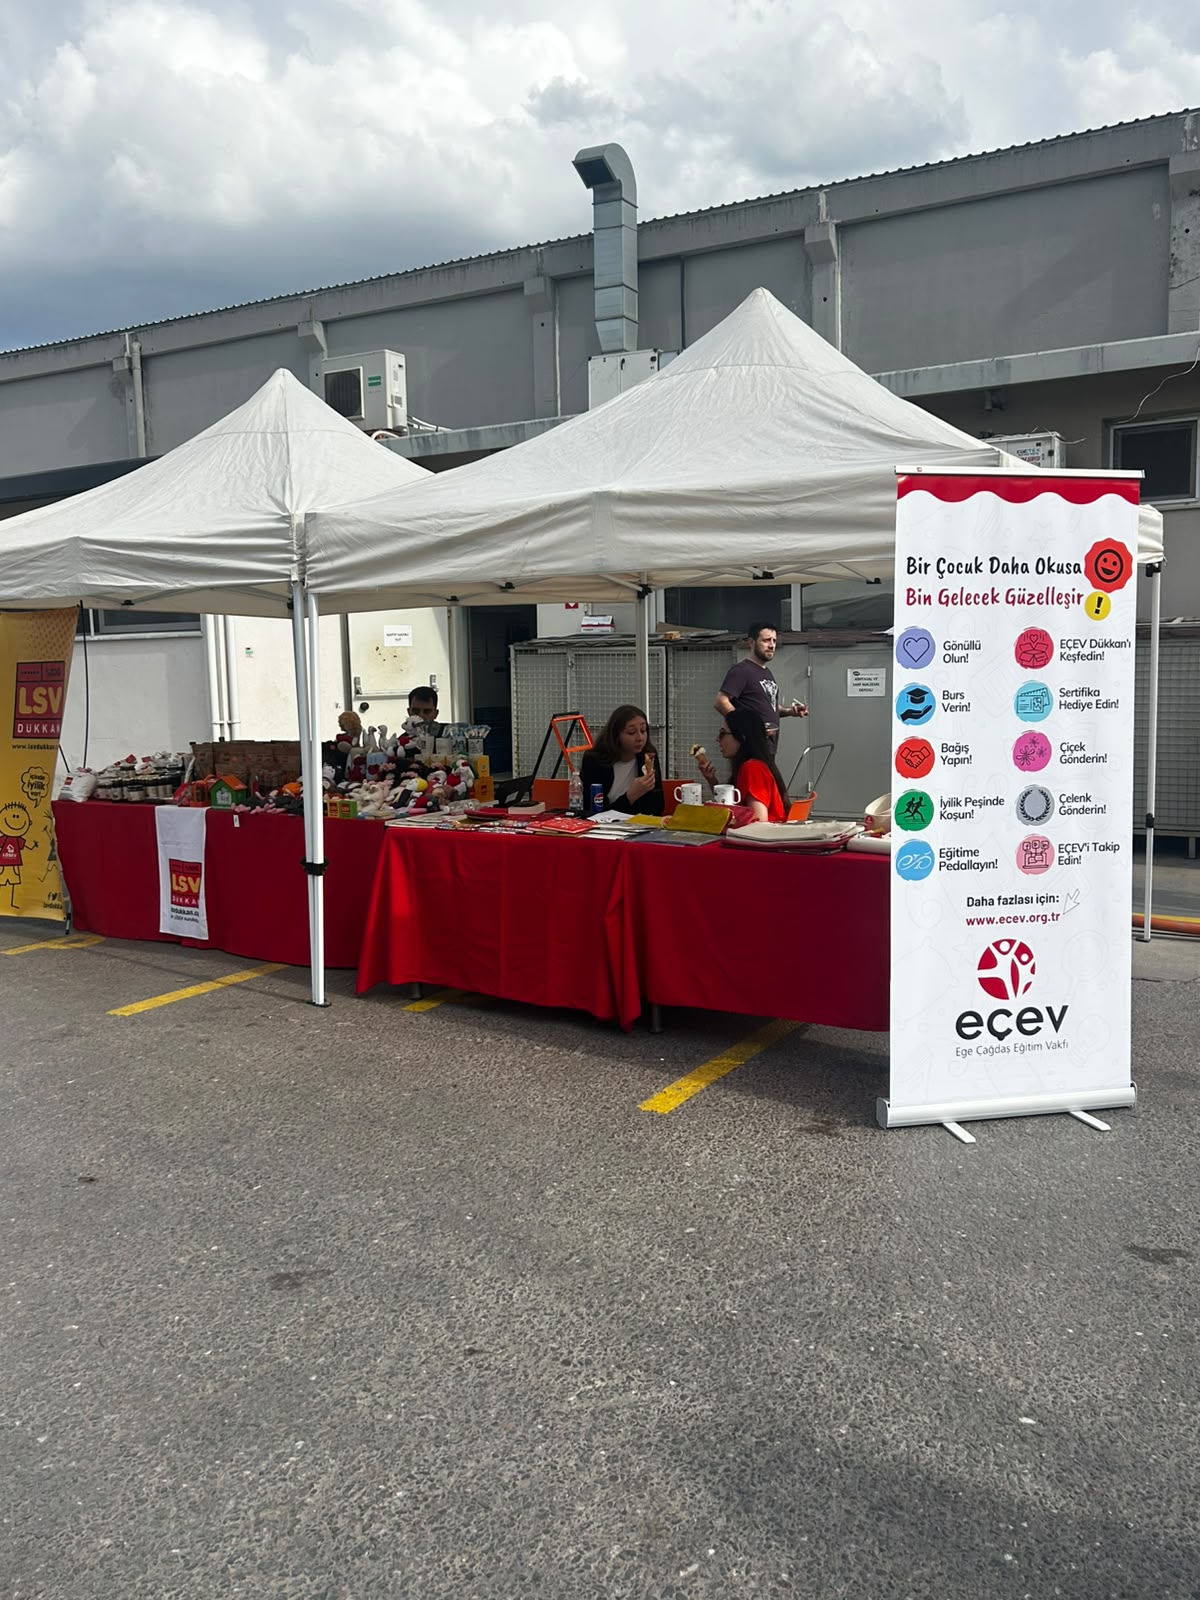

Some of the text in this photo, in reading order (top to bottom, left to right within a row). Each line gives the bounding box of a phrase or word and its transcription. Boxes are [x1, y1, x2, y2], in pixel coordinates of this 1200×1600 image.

[907, 556, 1082, 579] Bir Çocuk Daha Okusa
[906, 588, 932, 606] Bin
[938, 587, 1000, 607] Gelecek
[1005, 586, 1084, 609] Güzelleşir
[943, 640, 981, 651] Gönüllü
[1059, 639, 1087, 650] EÇEV
[943, 653, 968, 663] Olun!
[1060, 651, 1104, 663] Keşfedin!
[943, 690, 964, 700] Burs
[1059, 687, 1100, 697] Sertifika
[19, 686, 63, 714] LSV
[1059, 699, 1119, 711] Hediye Edin!
[942, 702, 970, 712] Verin!
[941, 742, 969, 754] Bağış
[1060, 742, 1086, 754] Çiçek
[940, 754, 972, 767] Yapın!
[1060, 753, 1107, 764] Gönderin!
[940, 795, 1004, 810] İyilik Peşinde
[1059, 793, 1091, 804] Çelenk
[940, 808, 974, 821] Koşun!
[1059, 804, 1106, 815] Gönderin!
[939, 847, 979, 860] Eğitime
[1058, 842, 1120, 856] EÇEV'i Takip
[939, 858, 998, 872] Pedallayın!
[1058, 854, 1081, 865] Edin!
[172, 873, 200, 893] LSV
[967, 893, 1059, 907] Daha fazlası için:
[966, 912, 1060, 926] www.ecev.org.tr
[955, 1005, 1069, 1041] eçev
[956, 1039, 1069, 1058] Ege Çağdaş Eğitim Vakfı
